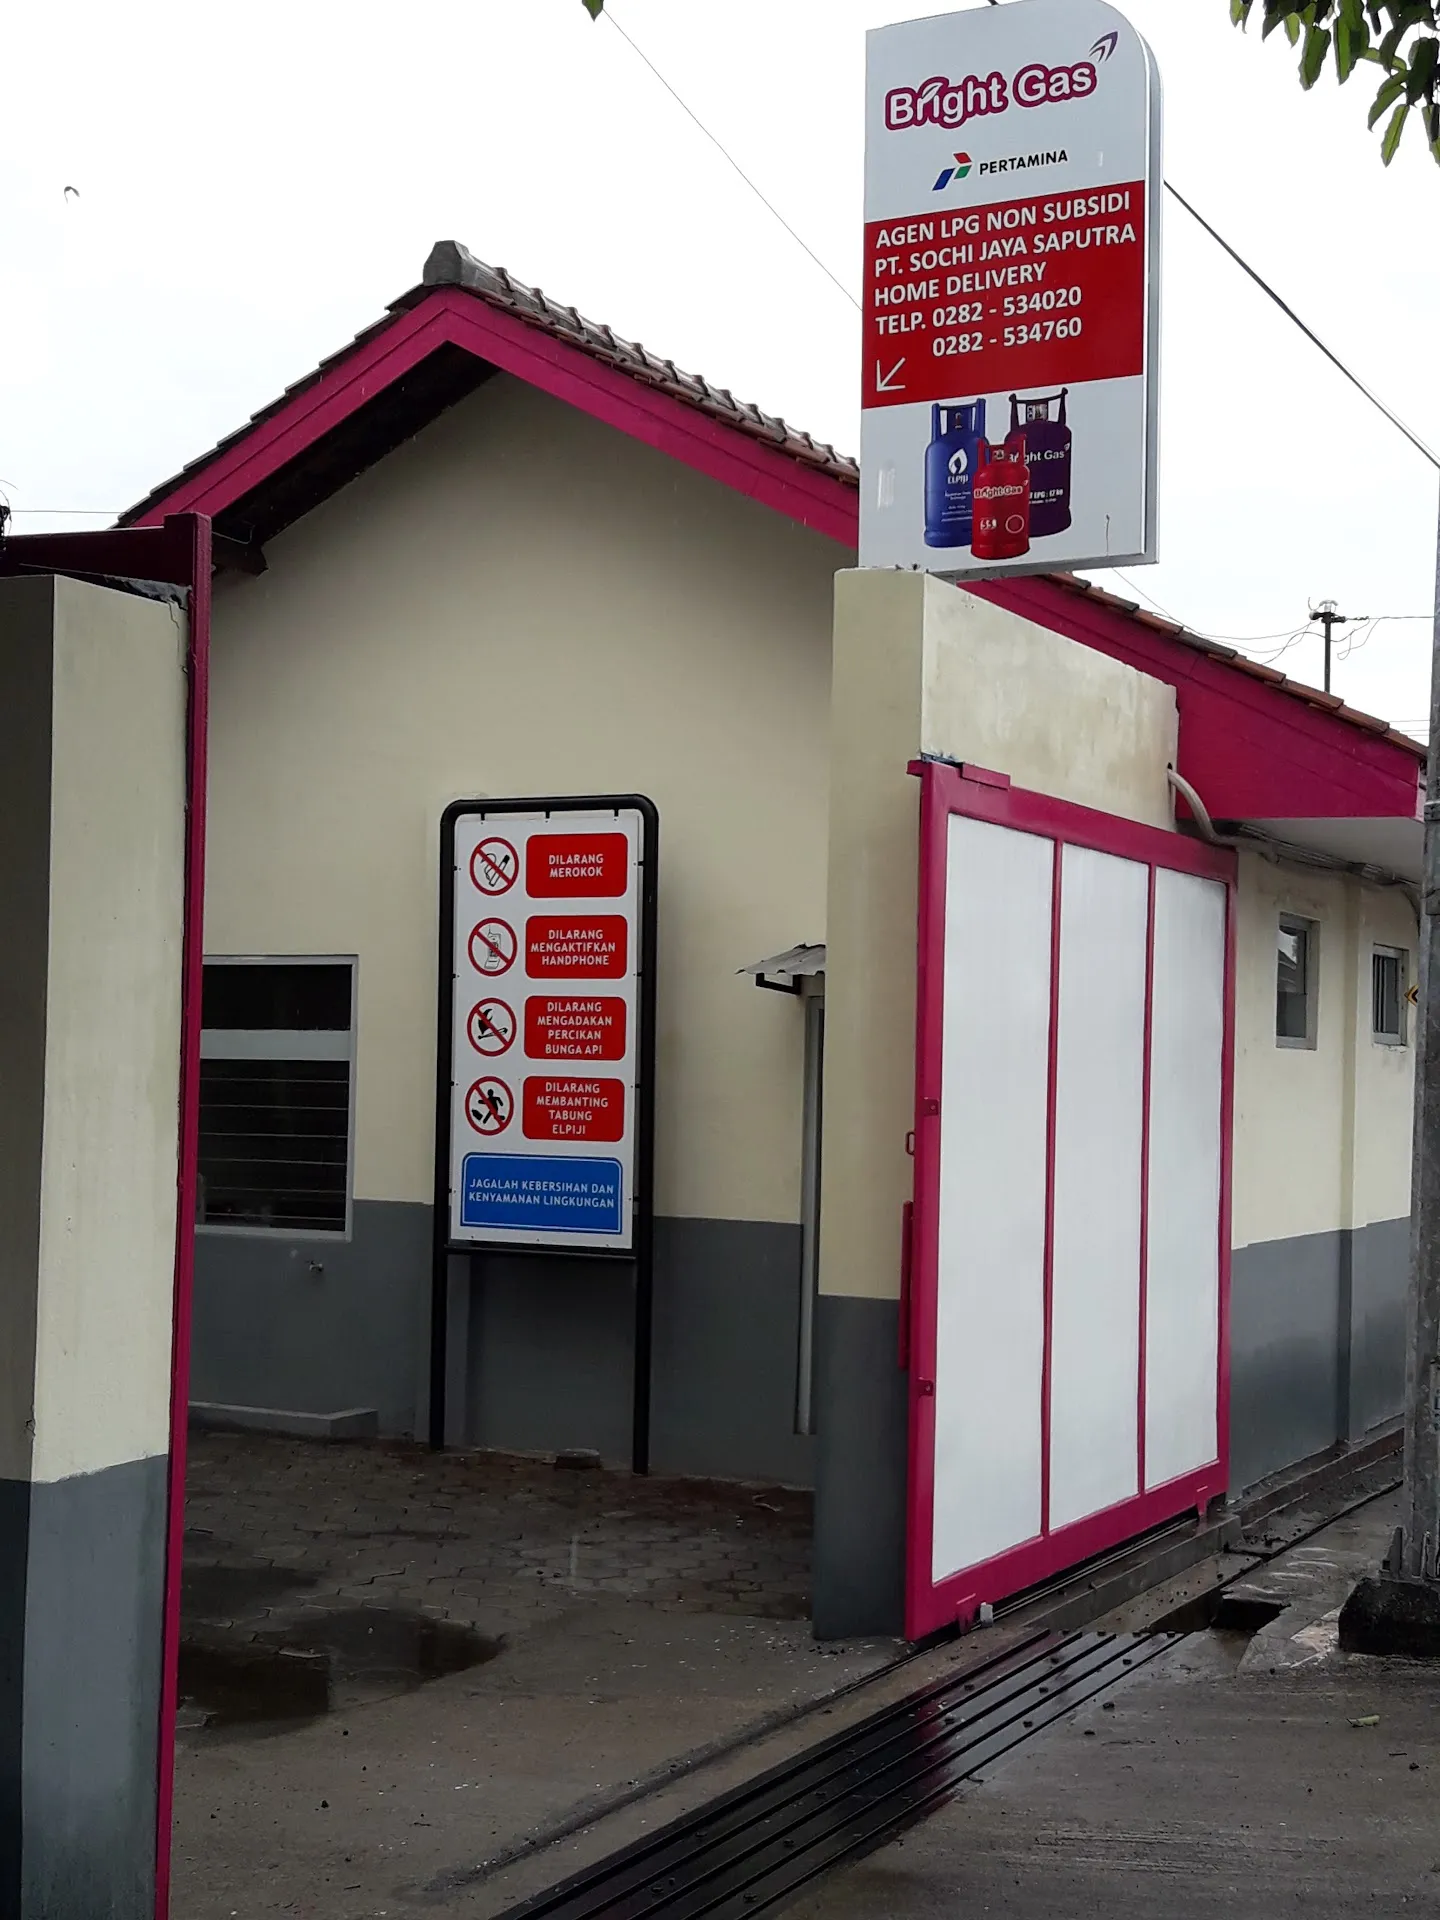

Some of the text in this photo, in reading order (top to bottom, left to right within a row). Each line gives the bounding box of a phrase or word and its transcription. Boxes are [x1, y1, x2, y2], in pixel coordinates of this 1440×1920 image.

[887, 65, 1094, 127] Bright Gas
[979, 149, 1069, 176] PERTAMINA
[875, 190, 1130, 249] AGEN LPG NON SUBSIDI
[874, 222, 1137, 278] PT. SOCHI JAYA SAPUTRA
[874, 261, 1048, 307] HOME DELIVERY
[874, 311, 926, 336] TELP.
[932, 301, 984, 328] 0282
[1003, 285, 1083, 318] 534020
[932, 331, 984, 357] 0282
[1003, 315, 1083, 347] 534760
[548, 853, 604, 865] DILARANG
[549, 866, 603, 878] MEROKOK
[548, 929, 604, 940] DILARANG
[530, 941, 616, 953] MENGAKTIFKAN
[541, 954, 610, 967] HANDPHONE
[546, 1001, 602, 1012] DILARANG
[537, 1015, 613, 1026] MENGADAKAN
[547, 1029, 602, 1041] PERCIKAN
[545, 1043, 603, 1055] BUNGA API
[545, 1082, 600, 1094] DILARANG
[536, 1096, 609, 1108] MEMBANTING
[548, 1109, 593, 1121] TABUNG
[552, 1124, 586, 1135] ELPIJI
[469, 1178, 615, 1195] JAGALAH KEBERSIHAN DAN
[469, 1191, 615, 1209] KENYAMANAN LINGKUNGAN
